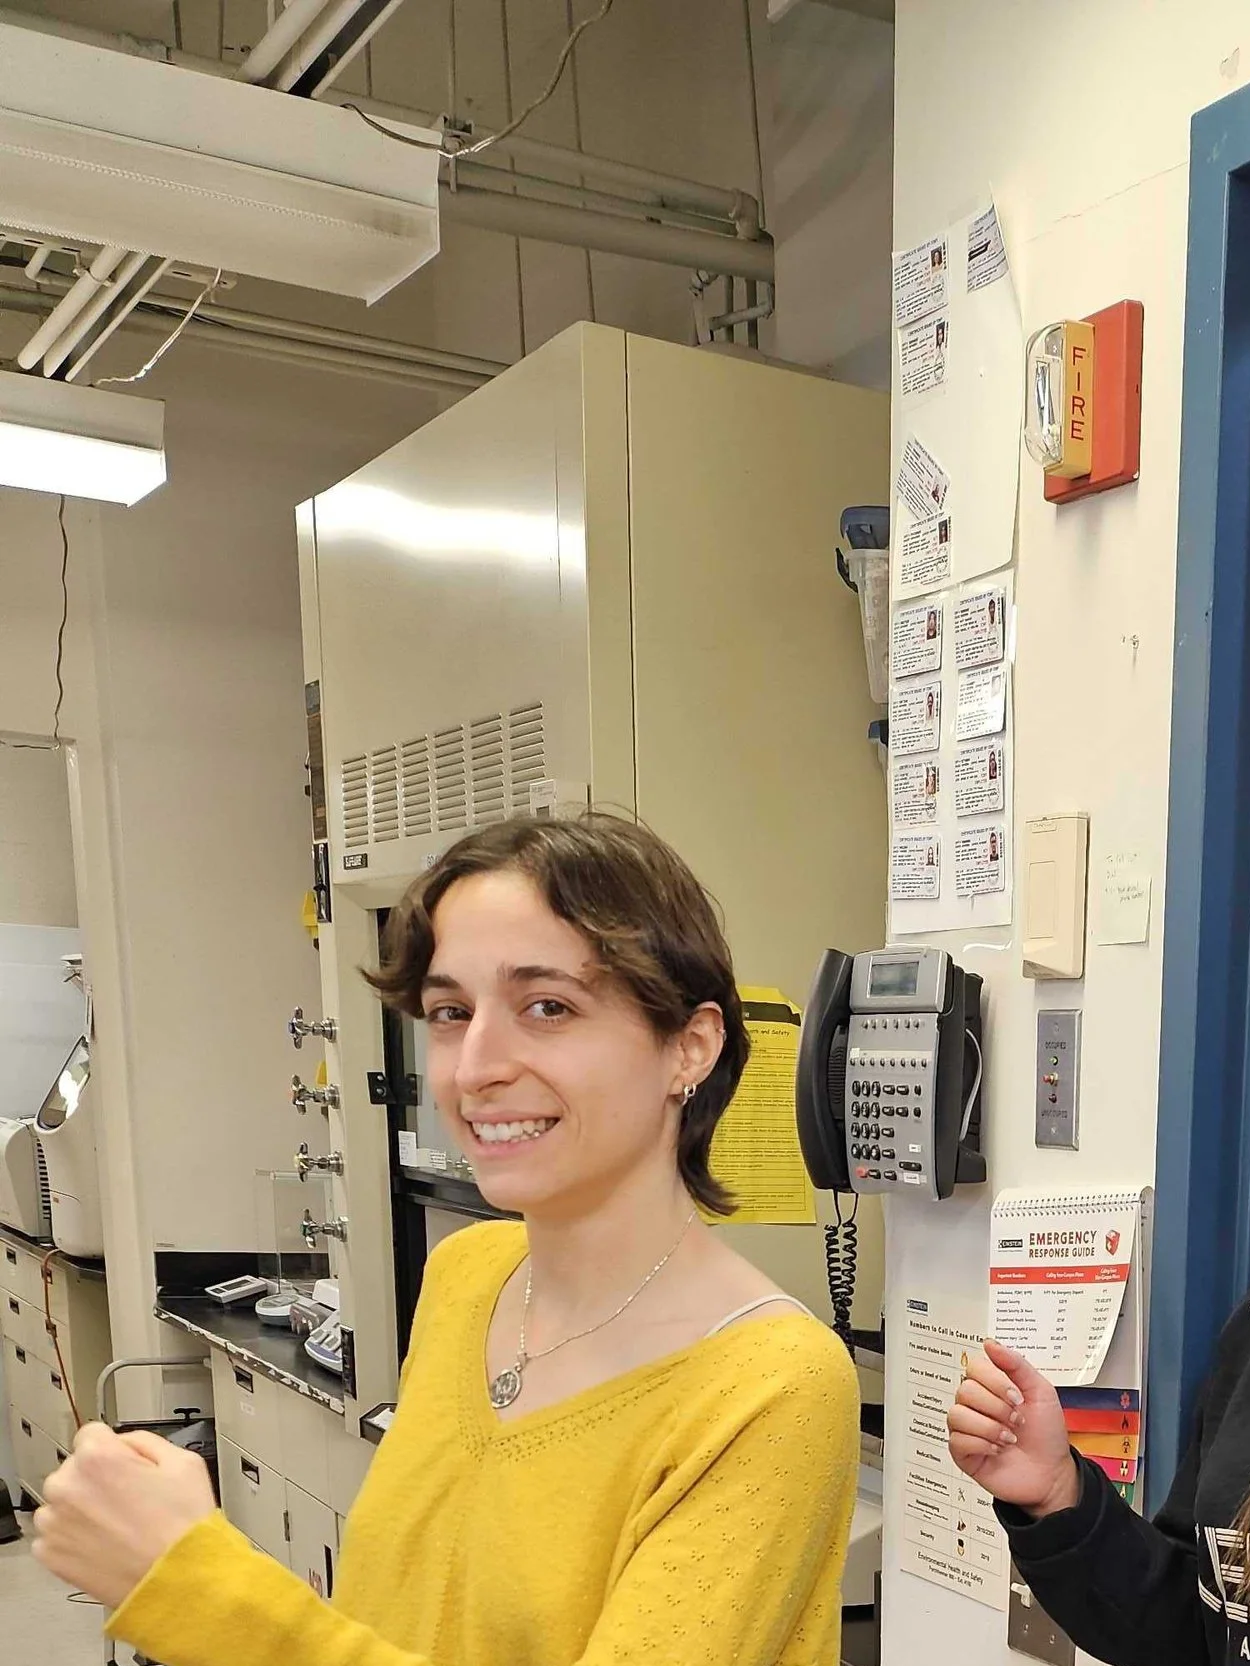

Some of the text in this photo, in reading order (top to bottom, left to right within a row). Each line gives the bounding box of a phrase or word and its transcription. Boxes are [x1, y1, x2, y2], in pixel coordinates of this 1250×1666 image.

[1071, 346, 1086, 441] FIRE
[1029, 1230, 1098, 1246] EMERGENCY
[1029, 1246, 1095, 1258] RESPONSE GUIDE
[909, 1320, 930, 1331] Numbers
[938, 1326, 948, 1335] Call
[956, 1330, 968, 1339] Case
